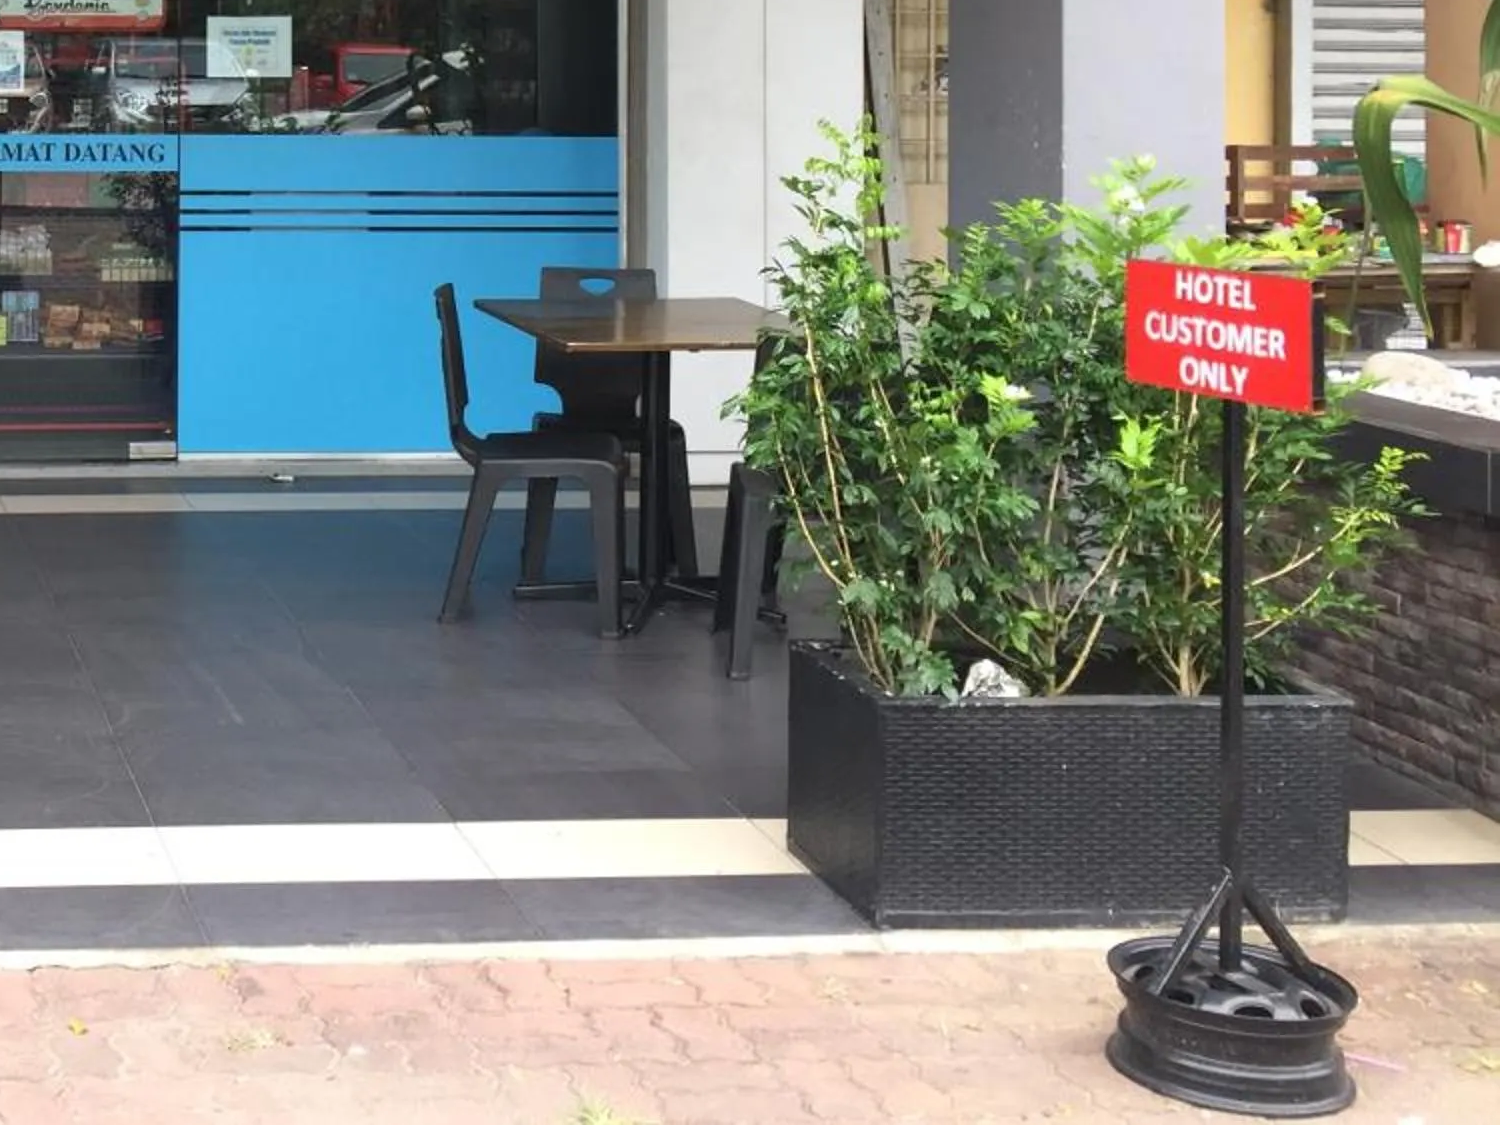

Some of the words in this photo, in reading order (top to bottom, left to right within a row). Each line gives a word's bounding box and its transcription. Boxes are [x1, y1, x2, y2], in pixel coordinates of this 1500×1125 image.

[64, 142, 165, 163] DATANG
[1174, 270, 1256, 311] HOTEL
[1144, 310, 1286, 360] CUSTOMER
[1179, 355, 1248, 395] ONLY
